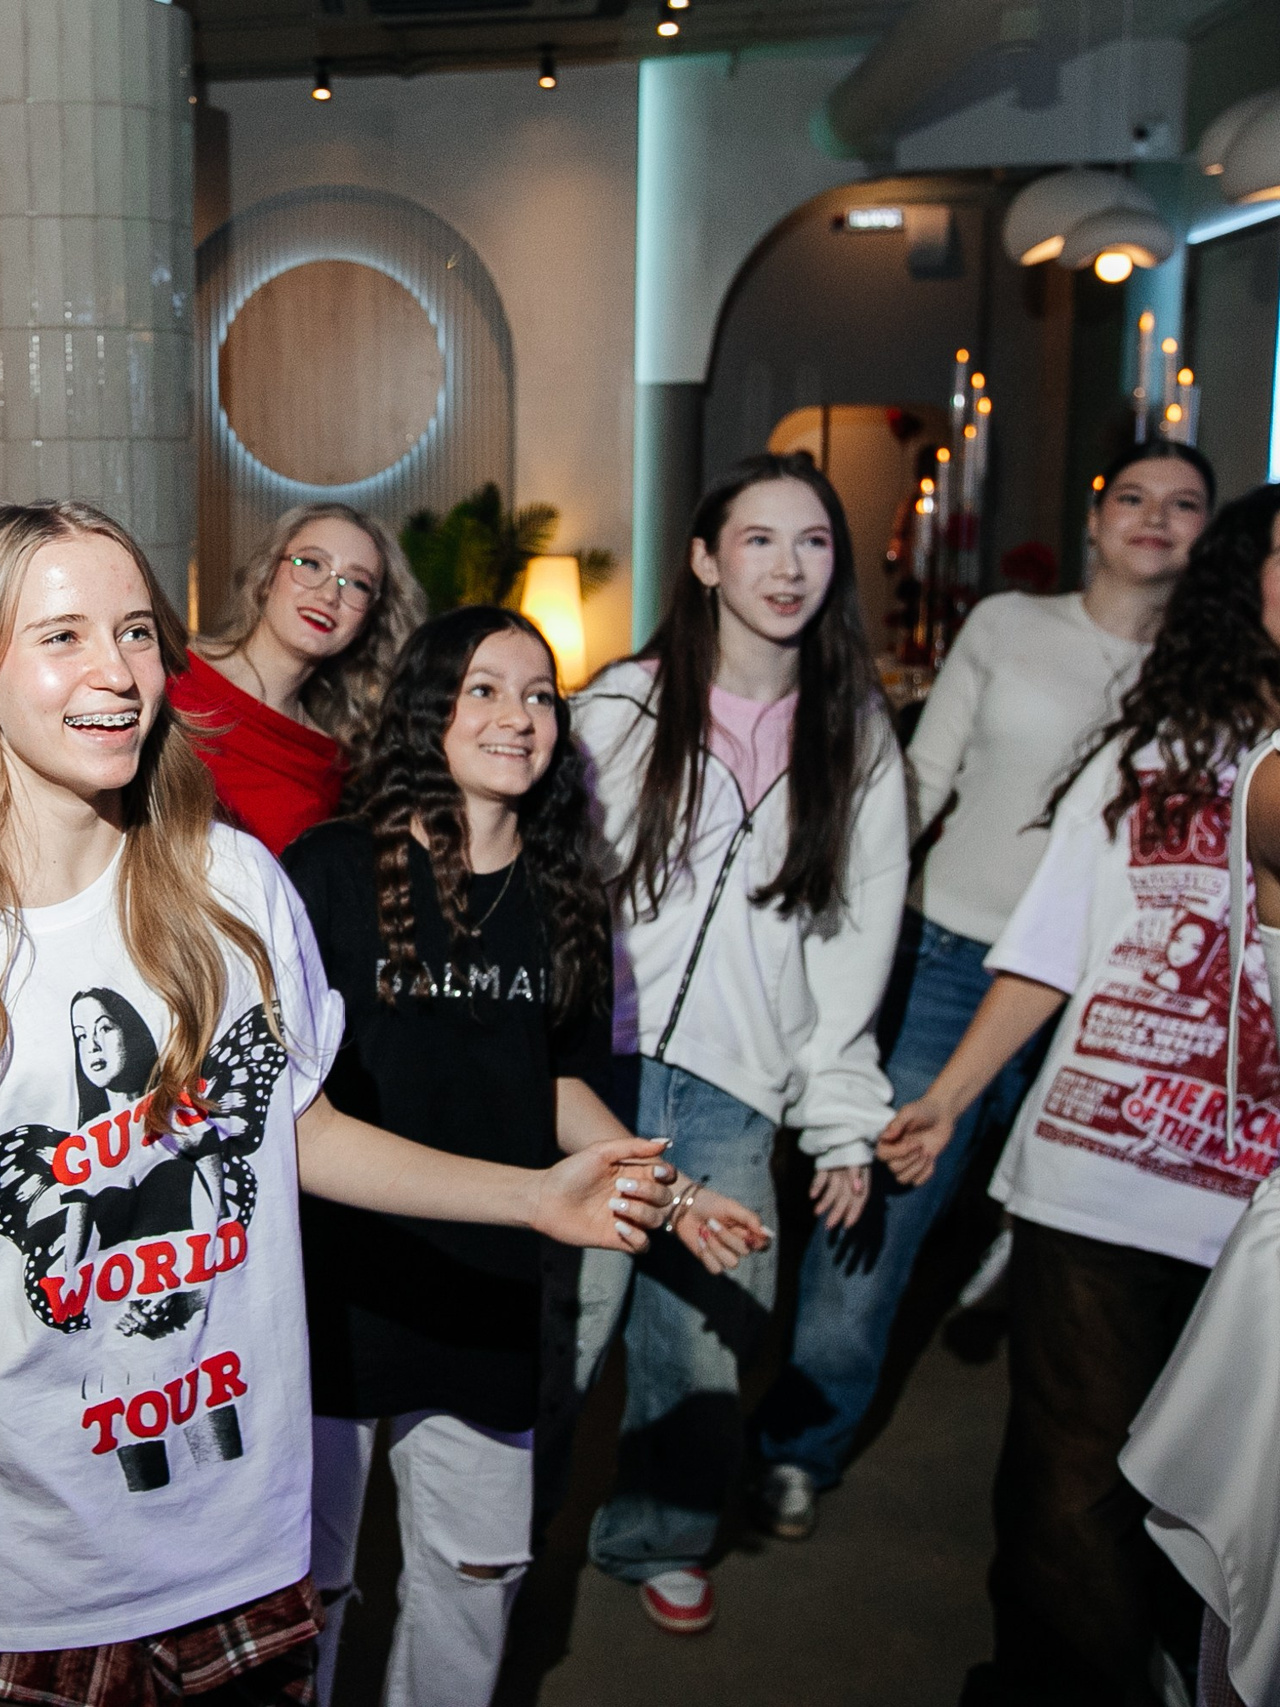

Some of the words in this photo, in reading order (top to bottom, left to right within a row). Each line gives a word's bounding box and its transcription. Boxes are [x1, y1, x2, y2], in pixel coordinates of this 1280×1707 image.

[1127, 1099, 1158, 1125] OF
[1158, 1113, 1203, 1152] THE
[1198, 1133, 1277, 1177] MOME
[1142, 1075, 1204, 1116] THE
[1199, 1089, 1280, 1150] ROCK
[39, 1220, 248, 1325] WORLD
[81, 1350, 248, 1456] TOUR
